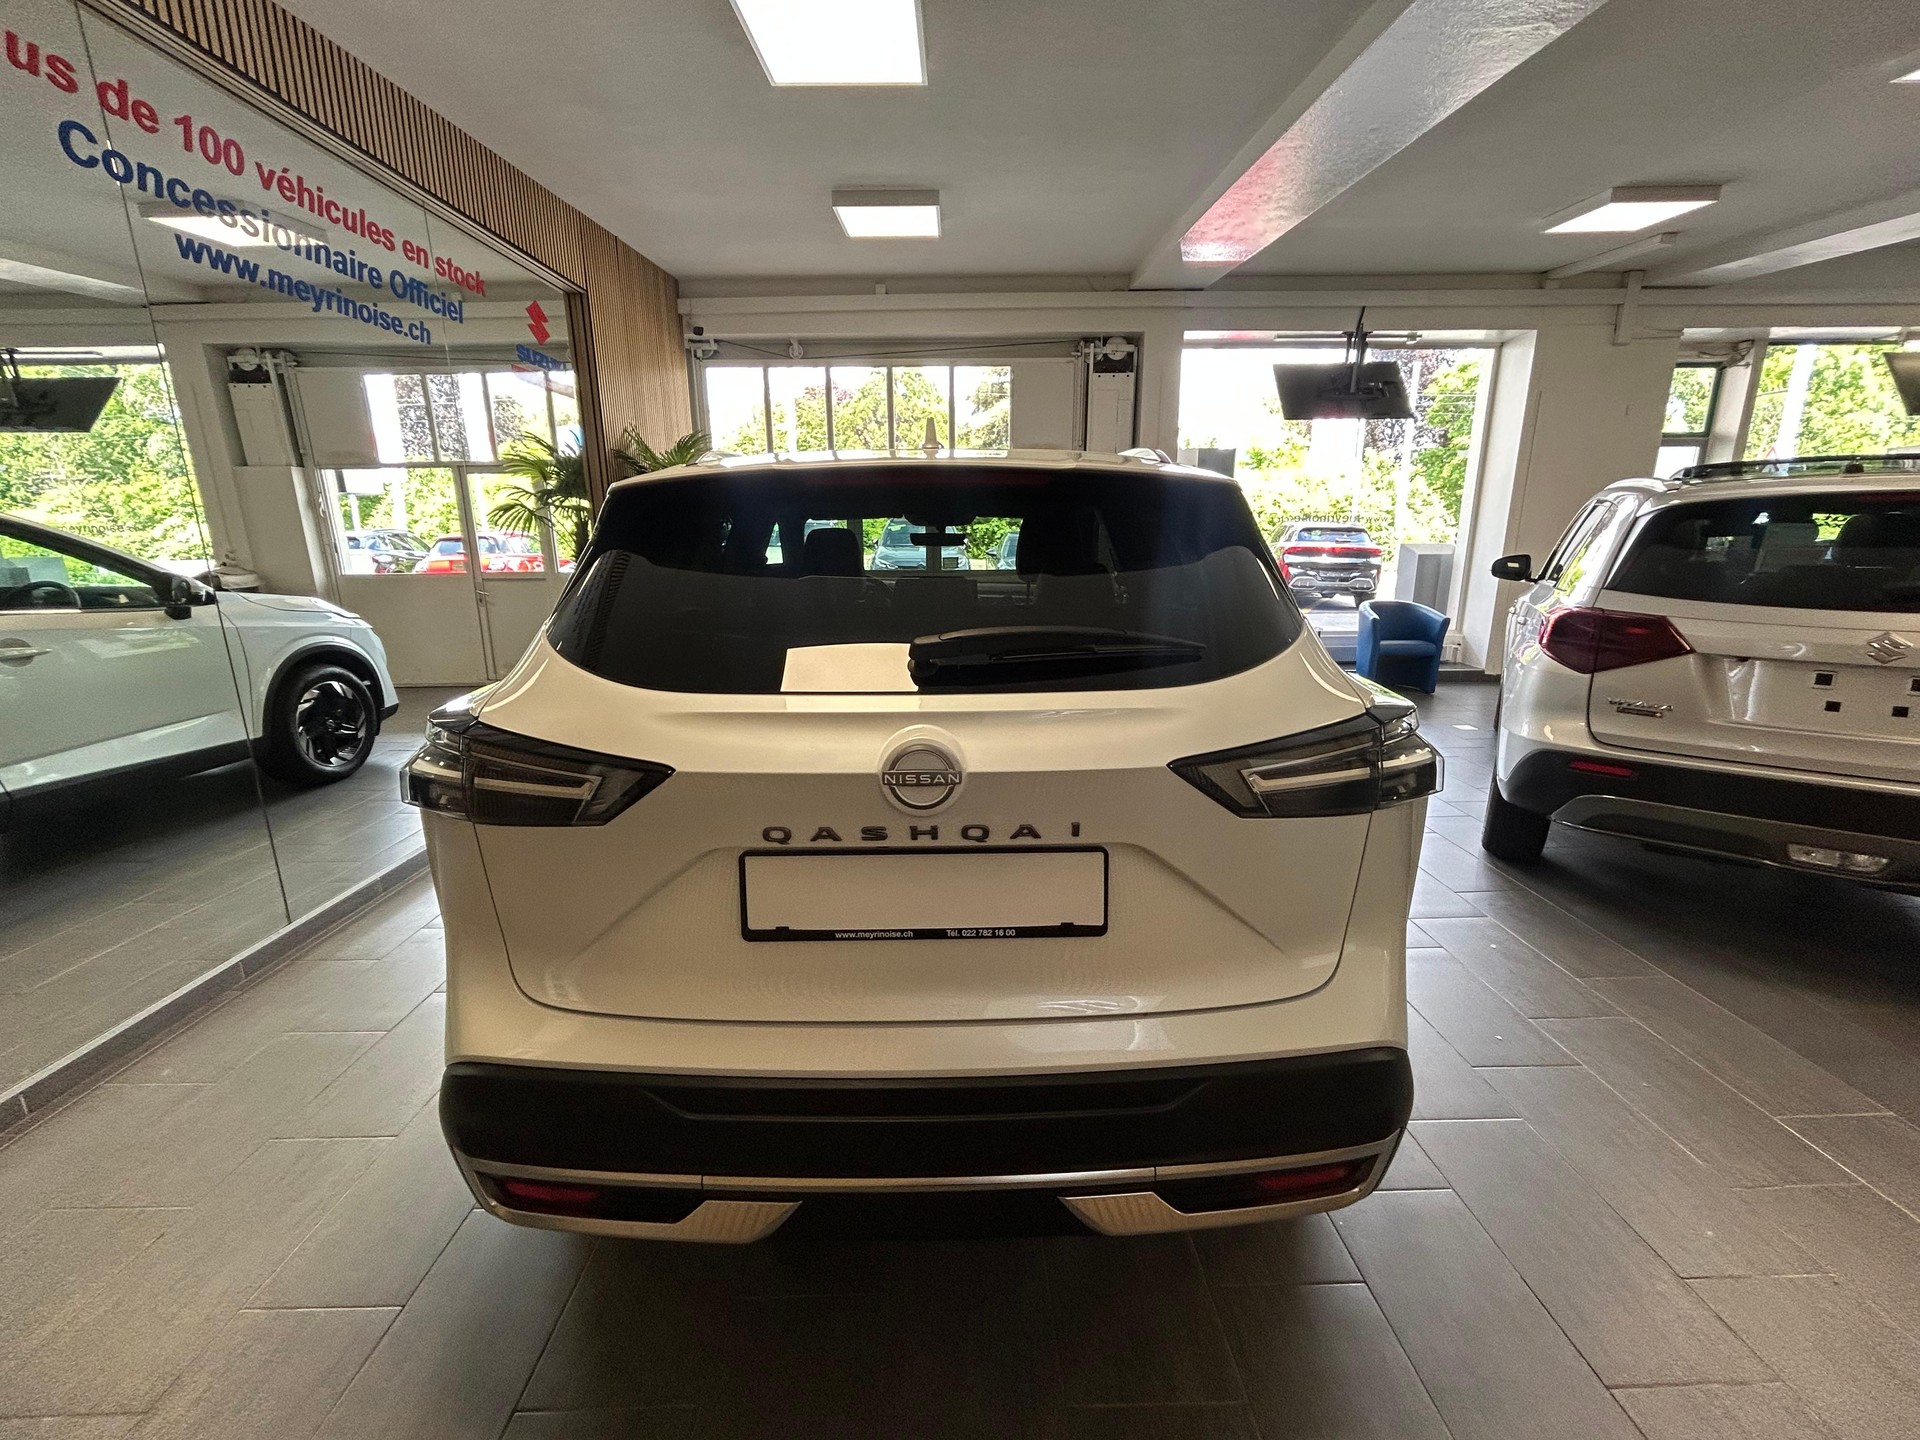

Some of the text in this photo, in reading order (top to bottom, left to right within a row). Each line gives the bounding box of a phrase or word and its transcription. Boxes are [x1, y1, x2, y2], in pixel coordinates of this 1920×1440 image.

[5, 30, 486, 297] us de 100 véhicules en stock
[58, 120, 464, 324] Concessionnaire Officiel
[174, 233, 432, 345] www.meyrinoise.ch
[884, 773, 960, 784] NISSAN
[762, 821, 1081, 845] QASHQAI
[835, 930, 914, 939] www.meyrinoise.ch
[961, 929, 976, 937] 022
[978, 929, 993, 937] 782
[994, 929, 1004, 937] 16
[1005, 929, 1016, 937] 00
